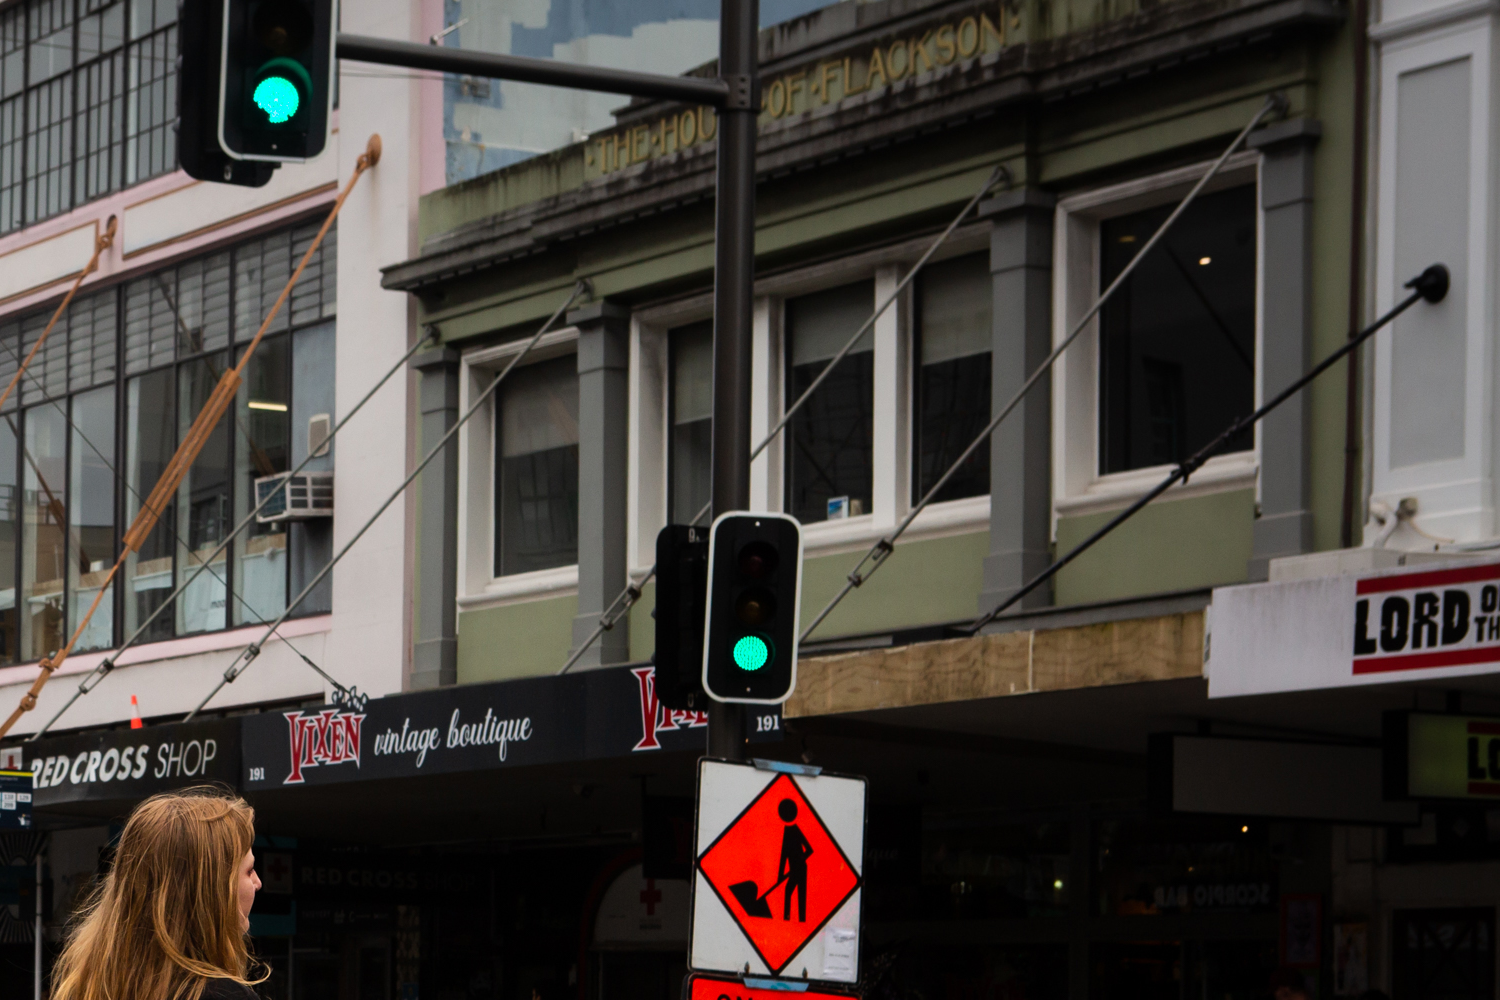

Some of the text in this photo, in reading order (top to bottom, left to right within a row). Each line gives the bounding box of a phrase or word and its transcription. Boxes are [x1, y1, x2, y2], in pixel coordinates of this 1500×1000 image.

[596, 6, 1005, 174] THE HOU OF FLACKSON
[1482, 585, 1500, 613] O
[1354, 590, 1470, 656] LORD
[756, 714, 779, 732] 191
[31, 739, 217, 790] RED CROSS SHOP
[283, 708, 532, 784] VIXEN vintage boutique
[249, 767, 265, 781] 191
[301, 866, 342, 885] RED
[346, 868, 418, 889] CROSS
